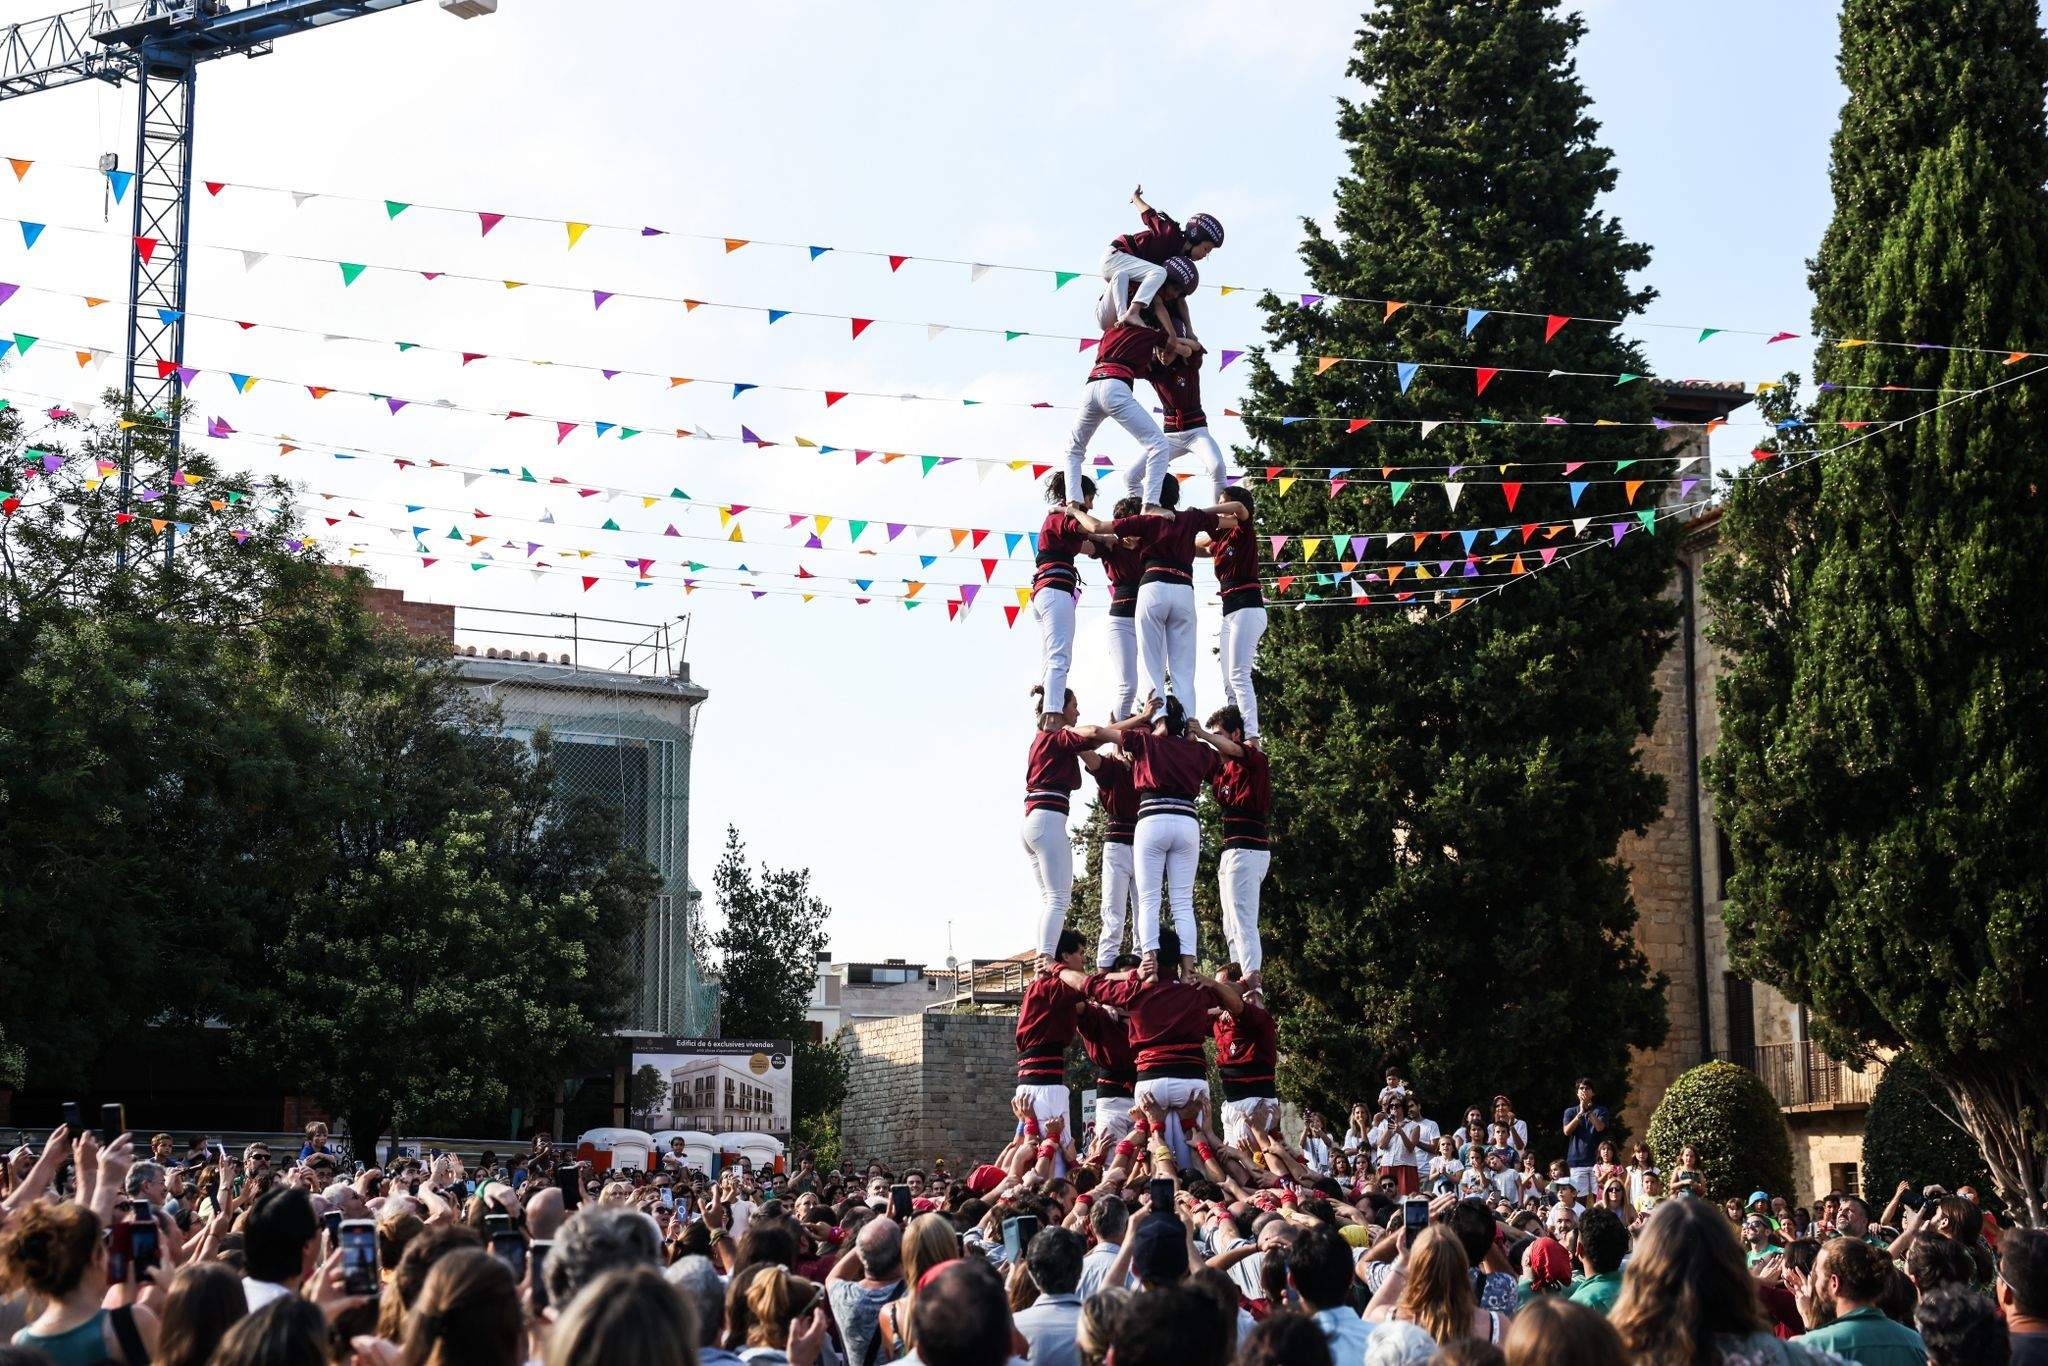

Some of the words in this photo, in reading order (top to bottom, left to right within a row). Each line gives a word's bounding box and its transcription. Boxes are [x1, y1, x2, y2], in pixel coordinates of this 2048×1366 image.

[1201, 215, 1222, 239] CANALLA
[1169, 261, 1190, 285] VALENTES
[1175, 256, 1195, 280] CANALLA
[676, 1039, 696, 1047] Edifici
[713, 1040, 745, 1048] exclusives
[745, 1040, 774, 1048] vivendes
